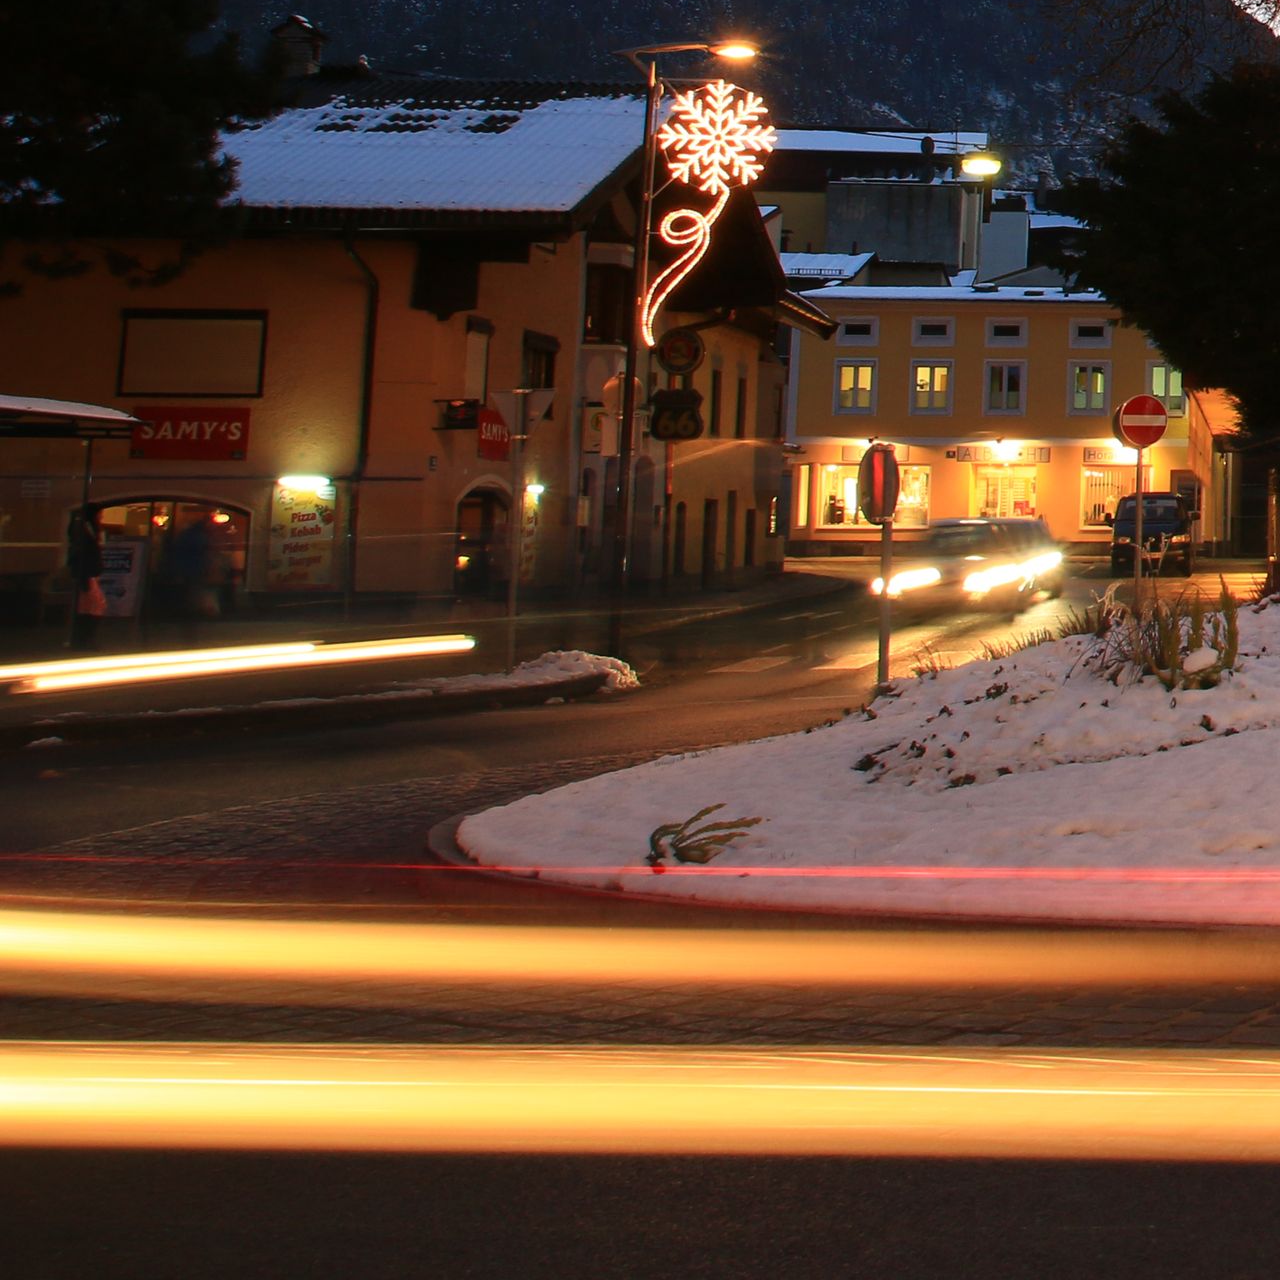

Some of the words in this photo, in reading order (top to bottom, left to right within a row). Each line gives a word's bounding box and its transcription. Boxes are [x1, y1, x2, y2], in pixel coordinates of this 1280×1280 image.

[141, 421, 243, 440] SAMY'S
[291, 512, 317, 523] Pizza
[290, 524, 322, 538] Kebab
